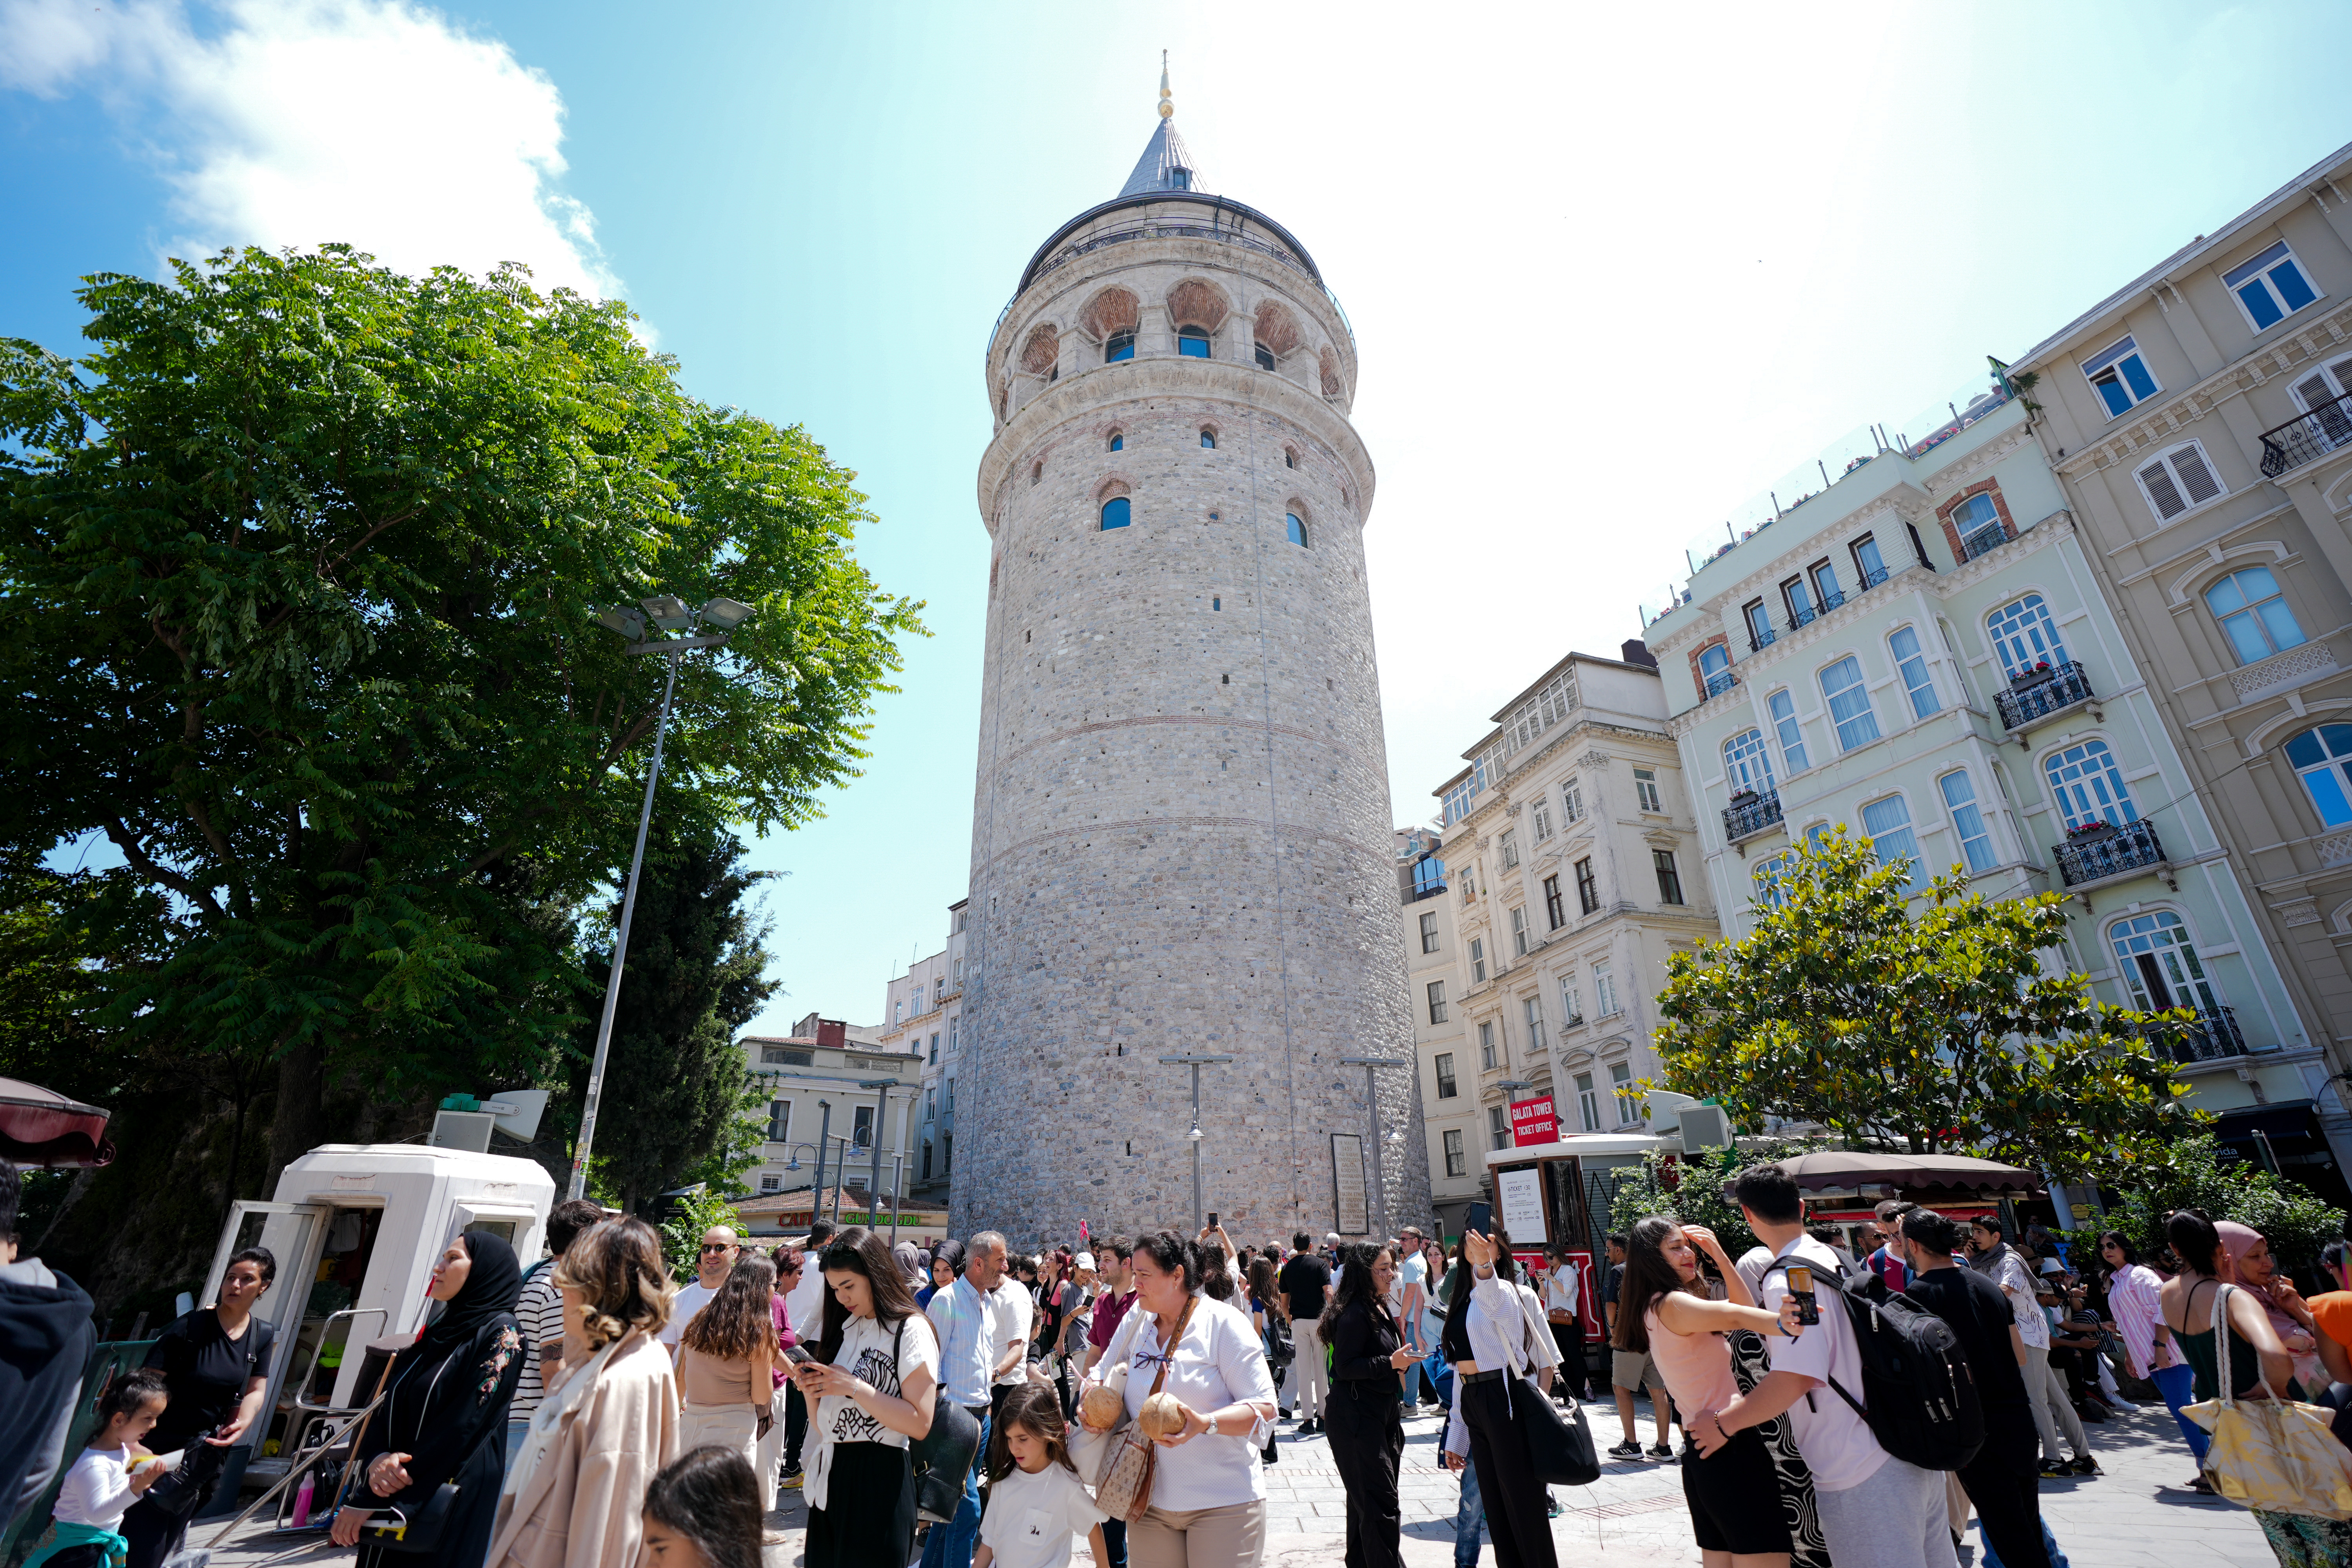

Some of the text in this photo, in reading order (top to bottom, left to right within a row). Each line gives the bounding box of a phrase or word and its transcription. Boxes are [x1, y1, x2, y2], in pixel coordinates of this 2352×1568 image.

[1512, 1102, 1552, 1121] GALATA TOWER
[1517, 1121, 1553, 1136] TICKET OFFICE
[1572, 1260, 1581, 1274] 4
